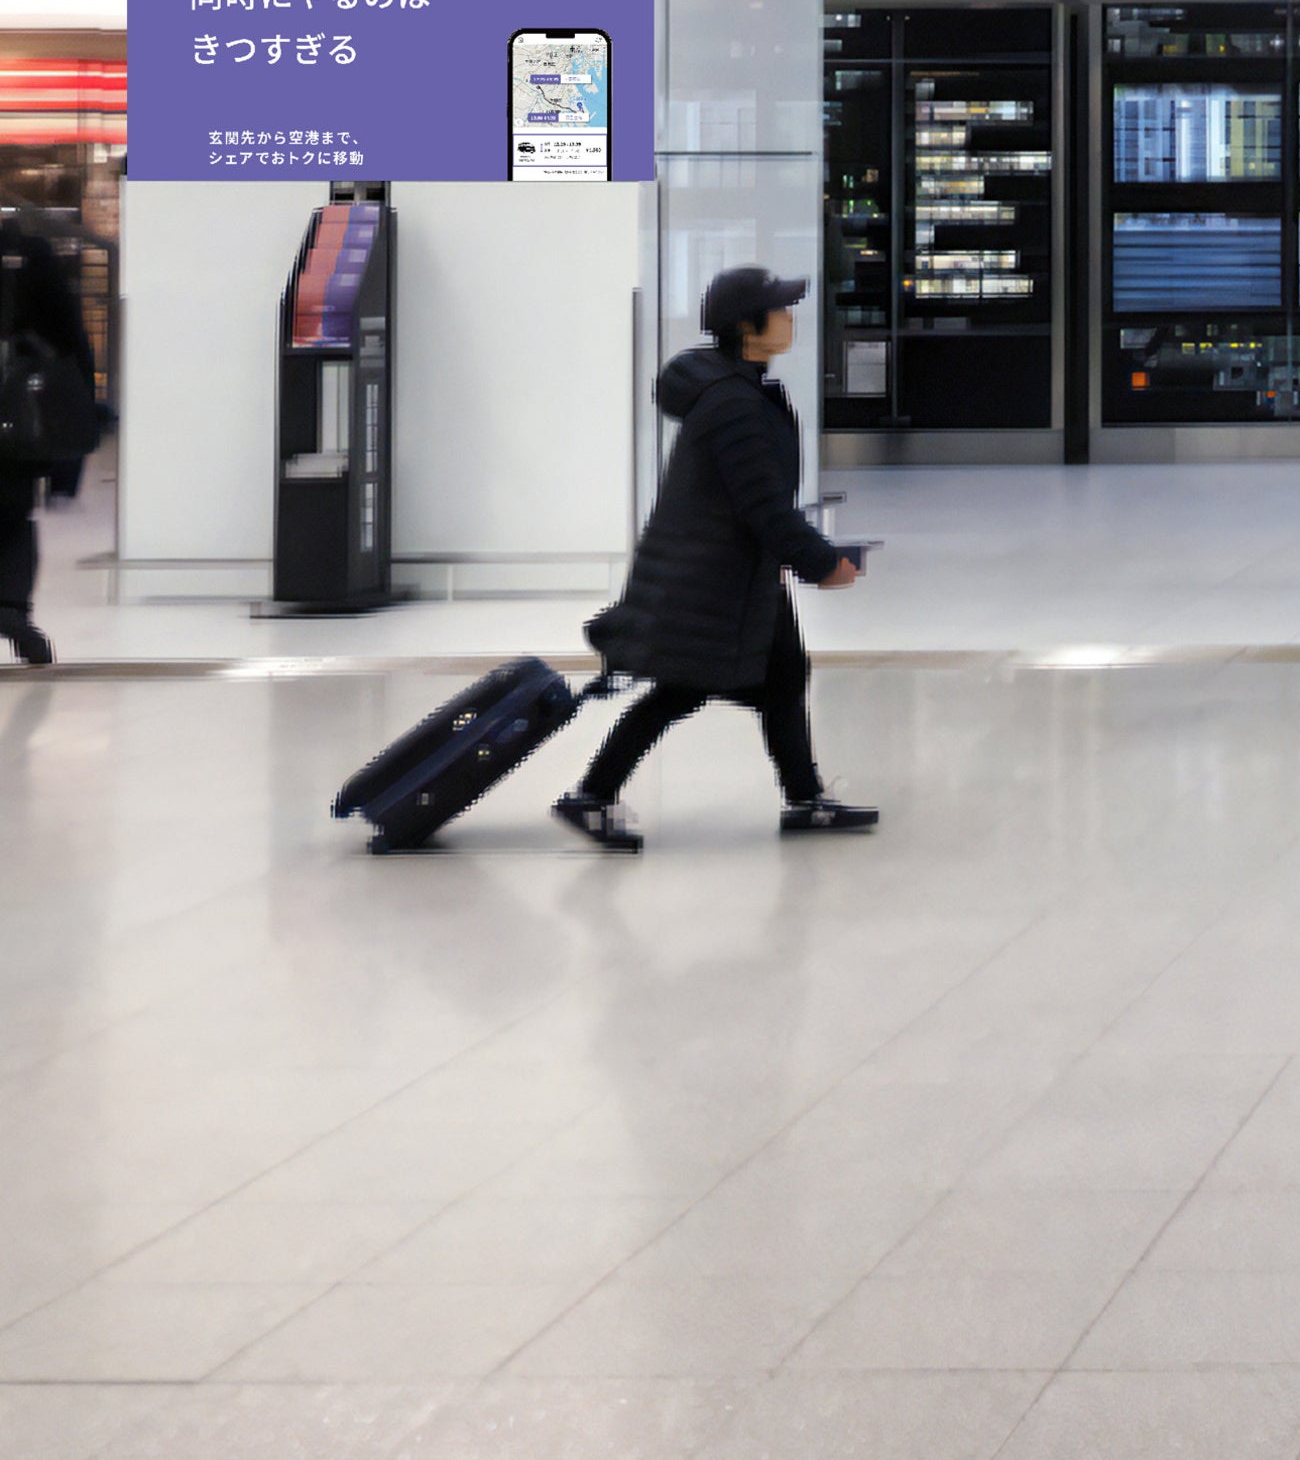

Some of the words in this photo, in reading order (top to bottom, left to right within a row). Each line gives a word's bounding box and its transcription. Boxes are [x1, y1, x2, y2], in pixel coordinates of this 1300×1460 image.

[193, 32, 357, 65] きつすぎる
[208, 129, 358, 146] 玄関先から空港まで、
[209, 150, 364, 166] シェアでおトクに移動
